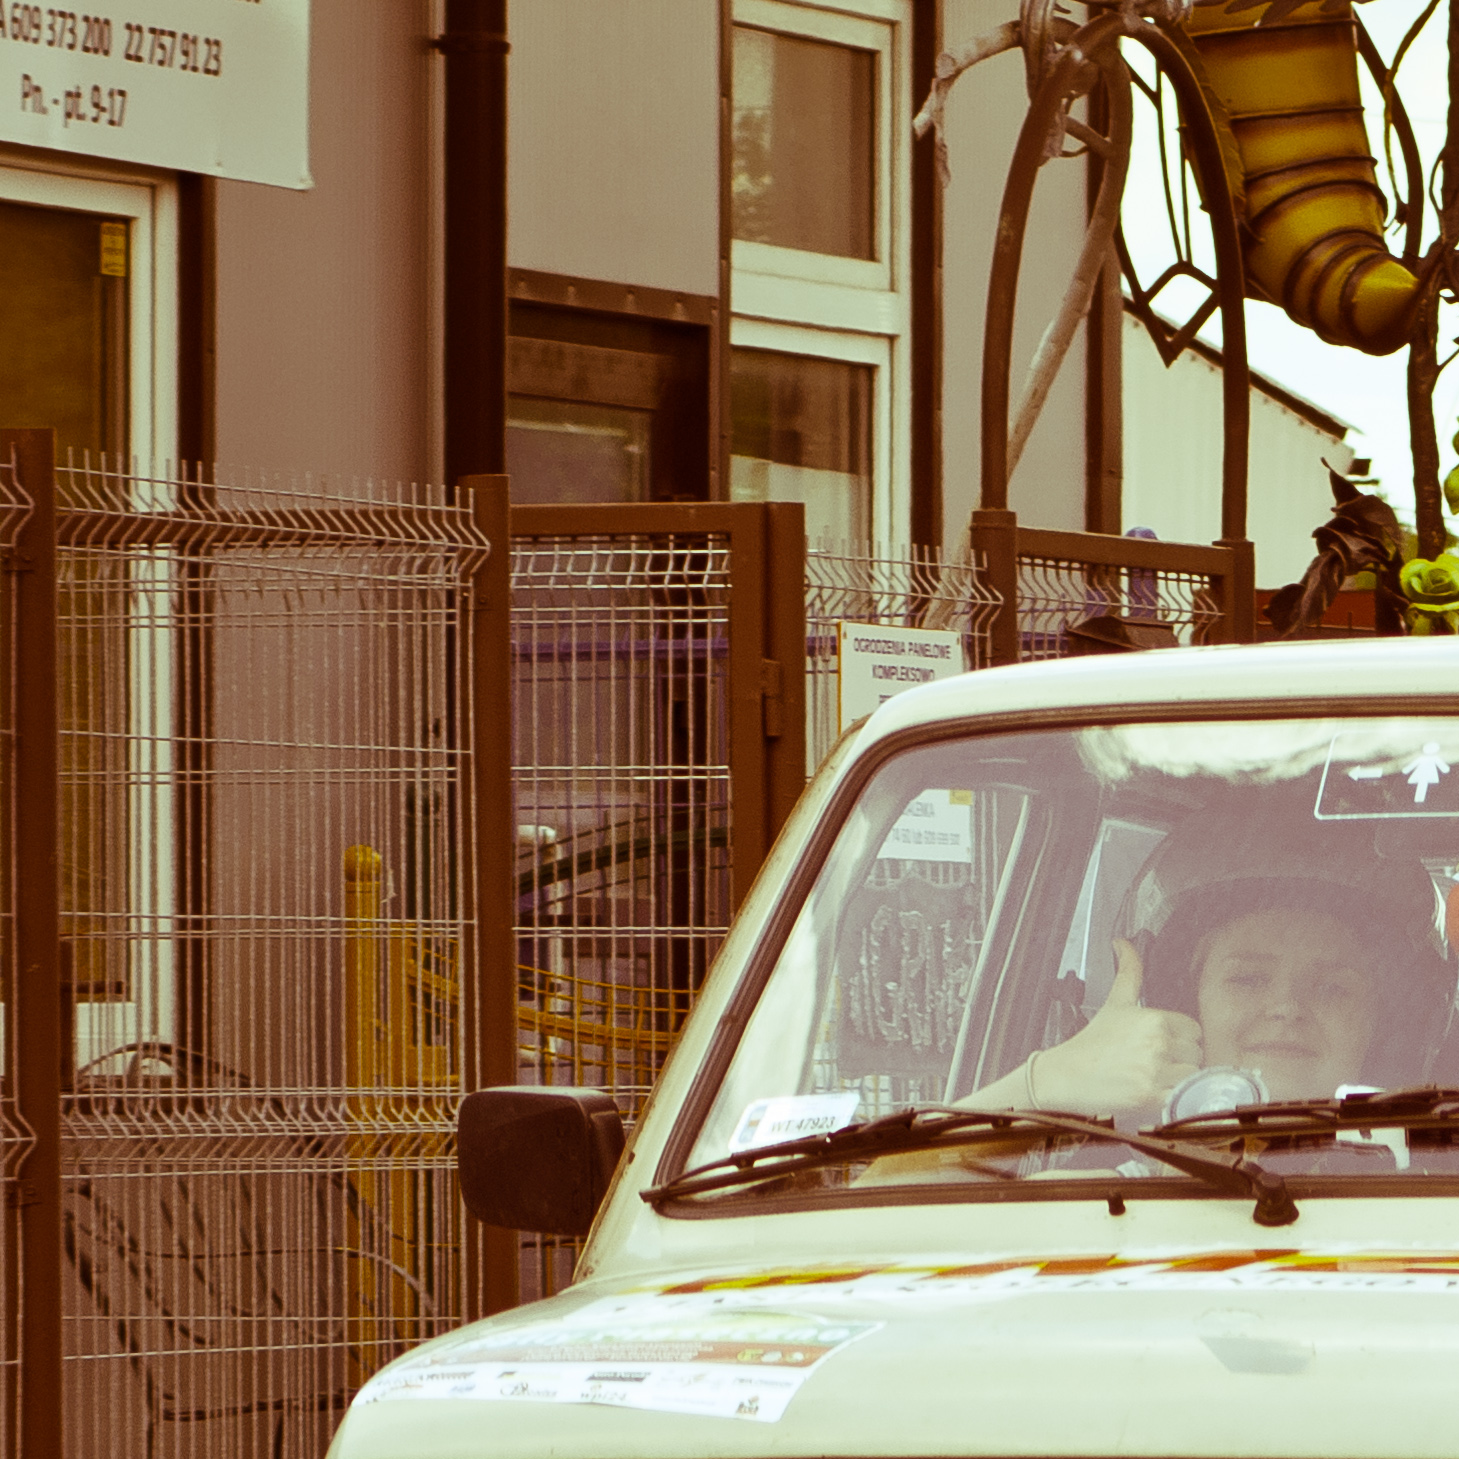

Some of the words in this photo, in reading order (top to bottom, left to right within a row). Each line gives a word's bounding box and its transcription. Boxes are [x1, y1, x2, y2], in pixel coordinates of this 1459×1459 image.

[11, 2, 41, 44] 609
[47, 8, 76, 50] 373
[82, 15, 111, 57] 200
[124, 22, 143, 63] 22
[148, 27, 176, 68] 757
[180, 32, 199, 73] 91
[203, 37, 222, 76] 23
[91, 85, 127, 127] 9-17
